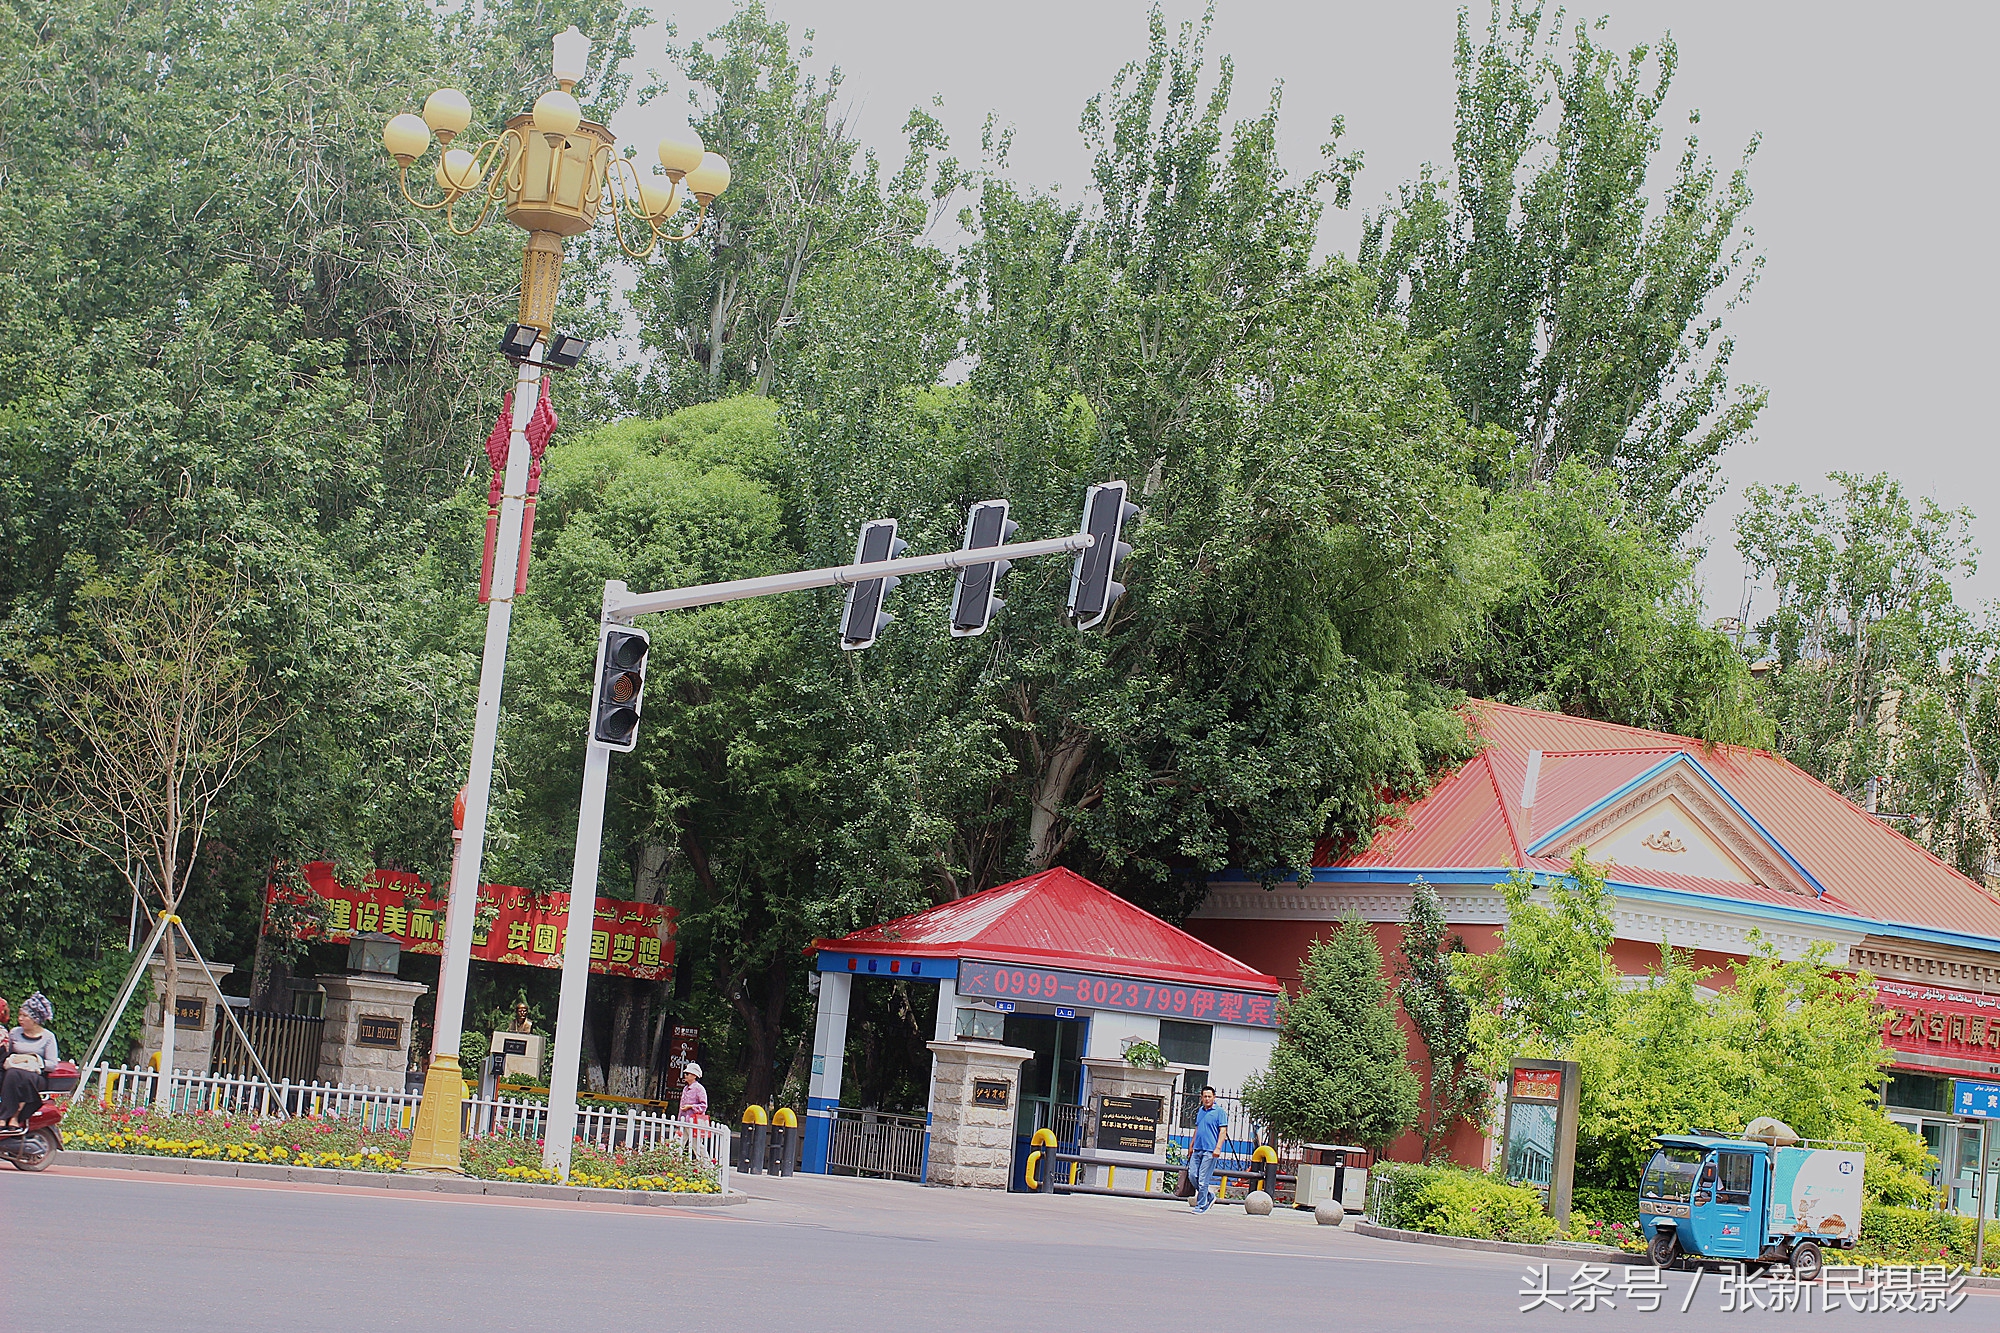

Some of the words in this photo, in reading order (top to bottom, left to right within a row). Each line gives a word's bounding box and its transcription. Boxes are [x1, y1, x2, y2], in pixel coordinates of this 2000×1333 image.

[327, 898, 488, 946] 建设美丽
[507, 920, 662, 966] 共圆国梦想
[362, 1025, 375, 1038] YILI
[376, 1026, 397, 1040] HOTEL
